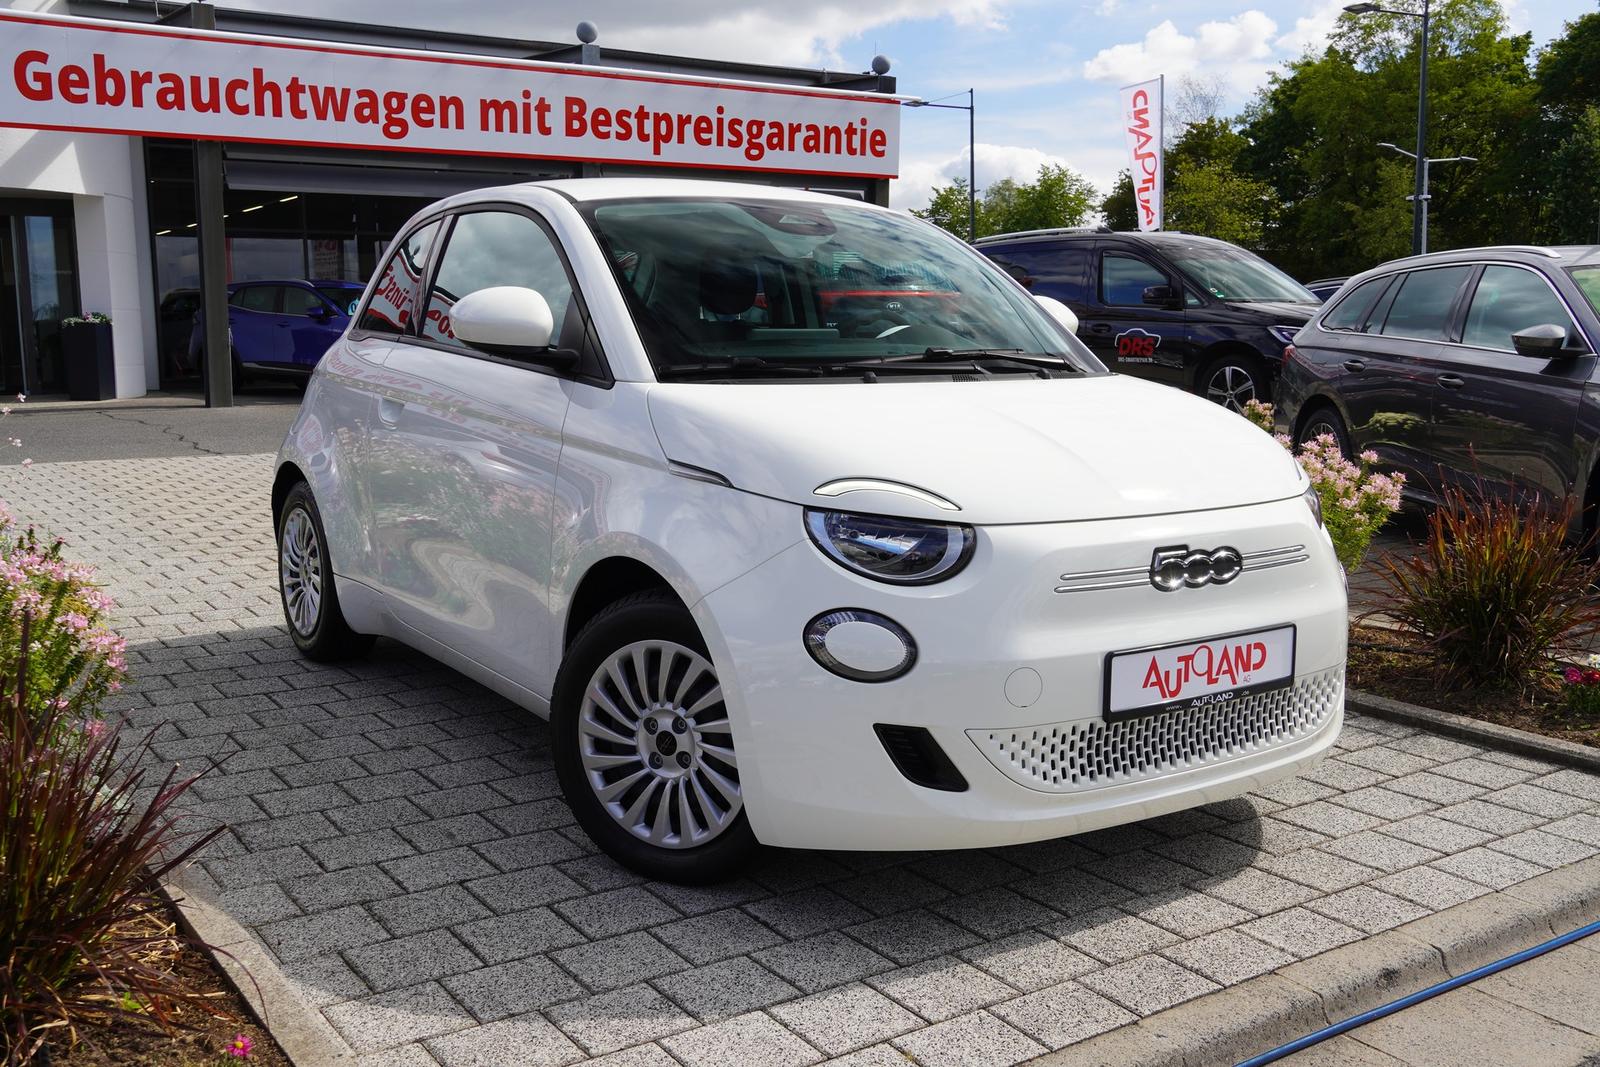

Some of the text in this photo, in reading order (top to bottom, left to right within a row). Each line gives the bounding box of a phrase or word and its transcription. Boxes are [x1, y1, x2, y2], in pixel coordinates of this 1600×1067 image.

[13, 50, 888, 162] Gebrauchtwagen mit Bestpreisgarantie
[1128, 90, 1157, 225] AUTOLAND
[1119, 336, 1153, 356] DRS
[1150, 544, 1243, 592] 500
[1142, 641, 1268, 699] AUTOLAND
[1243, 675, 1252, 684] AG
[1191, 691, 1234, 707] AUTOLAND
